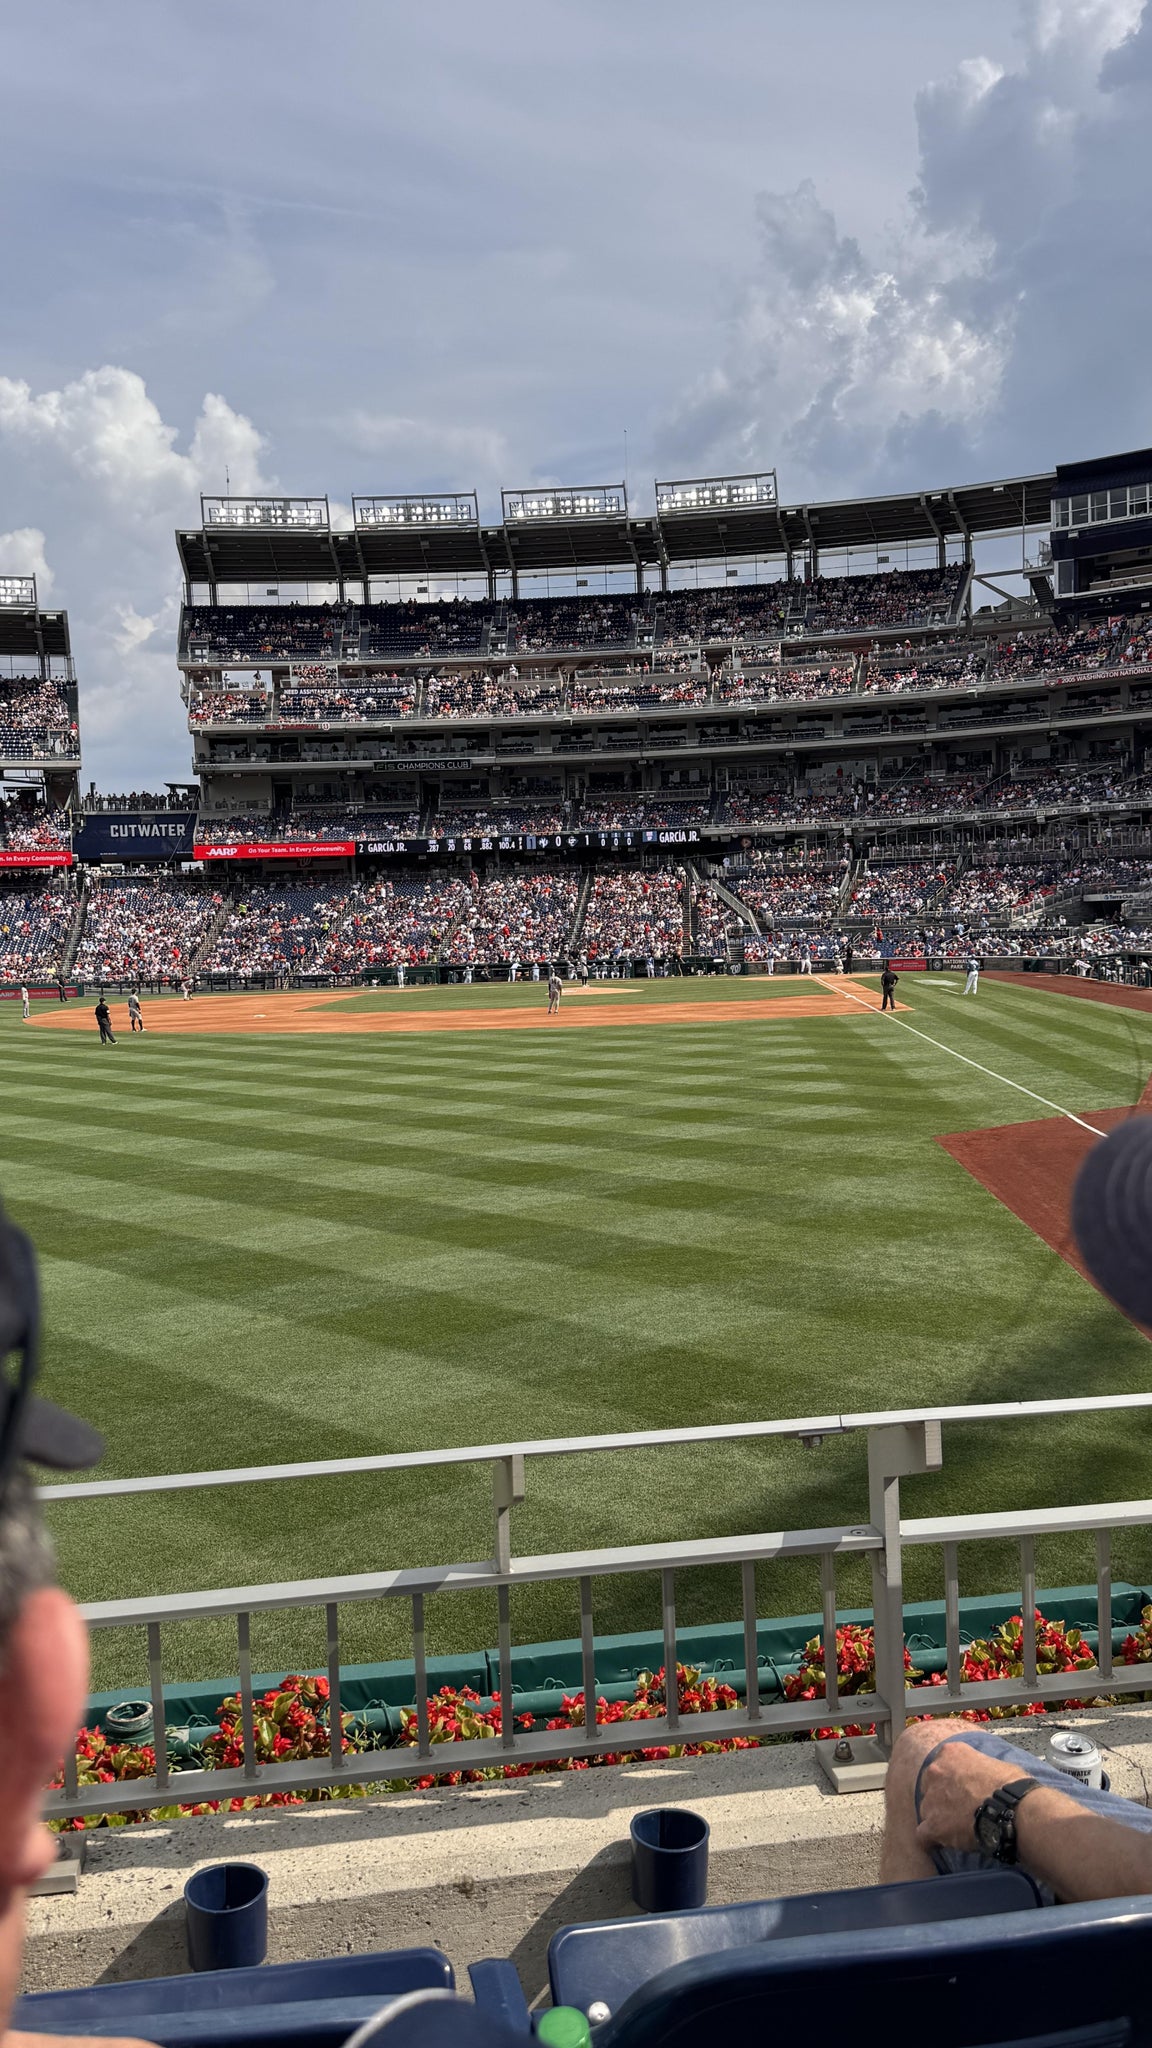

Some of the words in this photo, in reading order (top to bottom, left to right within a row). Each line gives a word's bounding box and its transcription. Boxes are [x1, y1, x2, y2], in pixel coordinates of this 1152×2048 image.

[1076, 671, 1119, 681] WASHINGTON
[397, 761, 446, 771] CHAMPIONS
[446, 760, 469, 769] CLUB
[110, 824, 186, 838] CUTWATER
[659, 829, 687, 843] GARCÍA
[688, 830, 700, 842] JR.
[480, 842, 493, 850] .882
[499, 841, 516, 850] 100.4
[555, 835, 562, 847] 0
[753, 837, 778, 847] PNC
[205, 847, 238, 857] AARP
[312, 846, 347, 854] Community.
[358, 843, 364, 853] 2
[368, 840, 394, 853] GARCÍA
[396, 842, 408, 852] JR.
[427, 844, 440, 853] .287
[464, 843, 472, 851] 68
